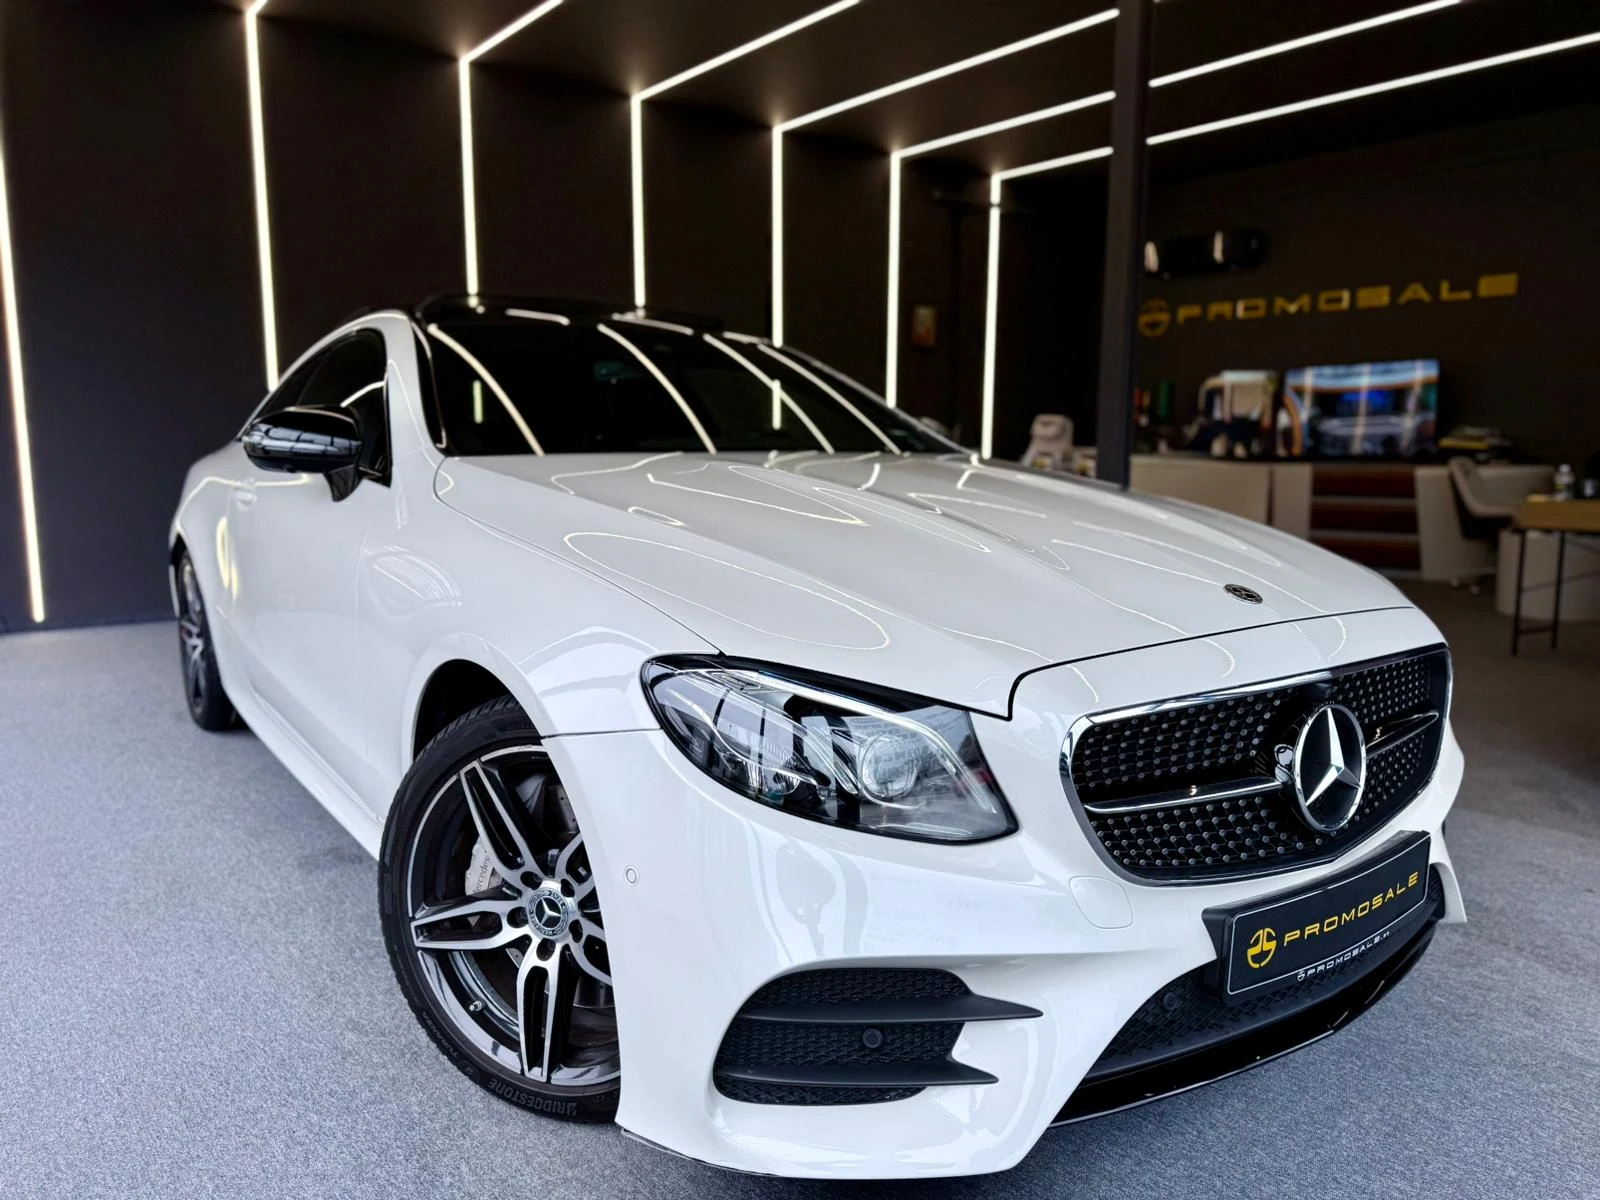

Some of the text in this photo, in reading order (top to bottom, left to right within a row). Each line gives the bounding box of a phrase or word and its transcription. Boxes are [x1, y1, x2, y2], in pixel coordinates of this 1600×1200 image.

[1283, 871, 1420, 947] PROMOSALE
[1306, 931, 1390, 977] PROMOSALE.
[487, 1077, 579, 1117] BRIDGESTONE
